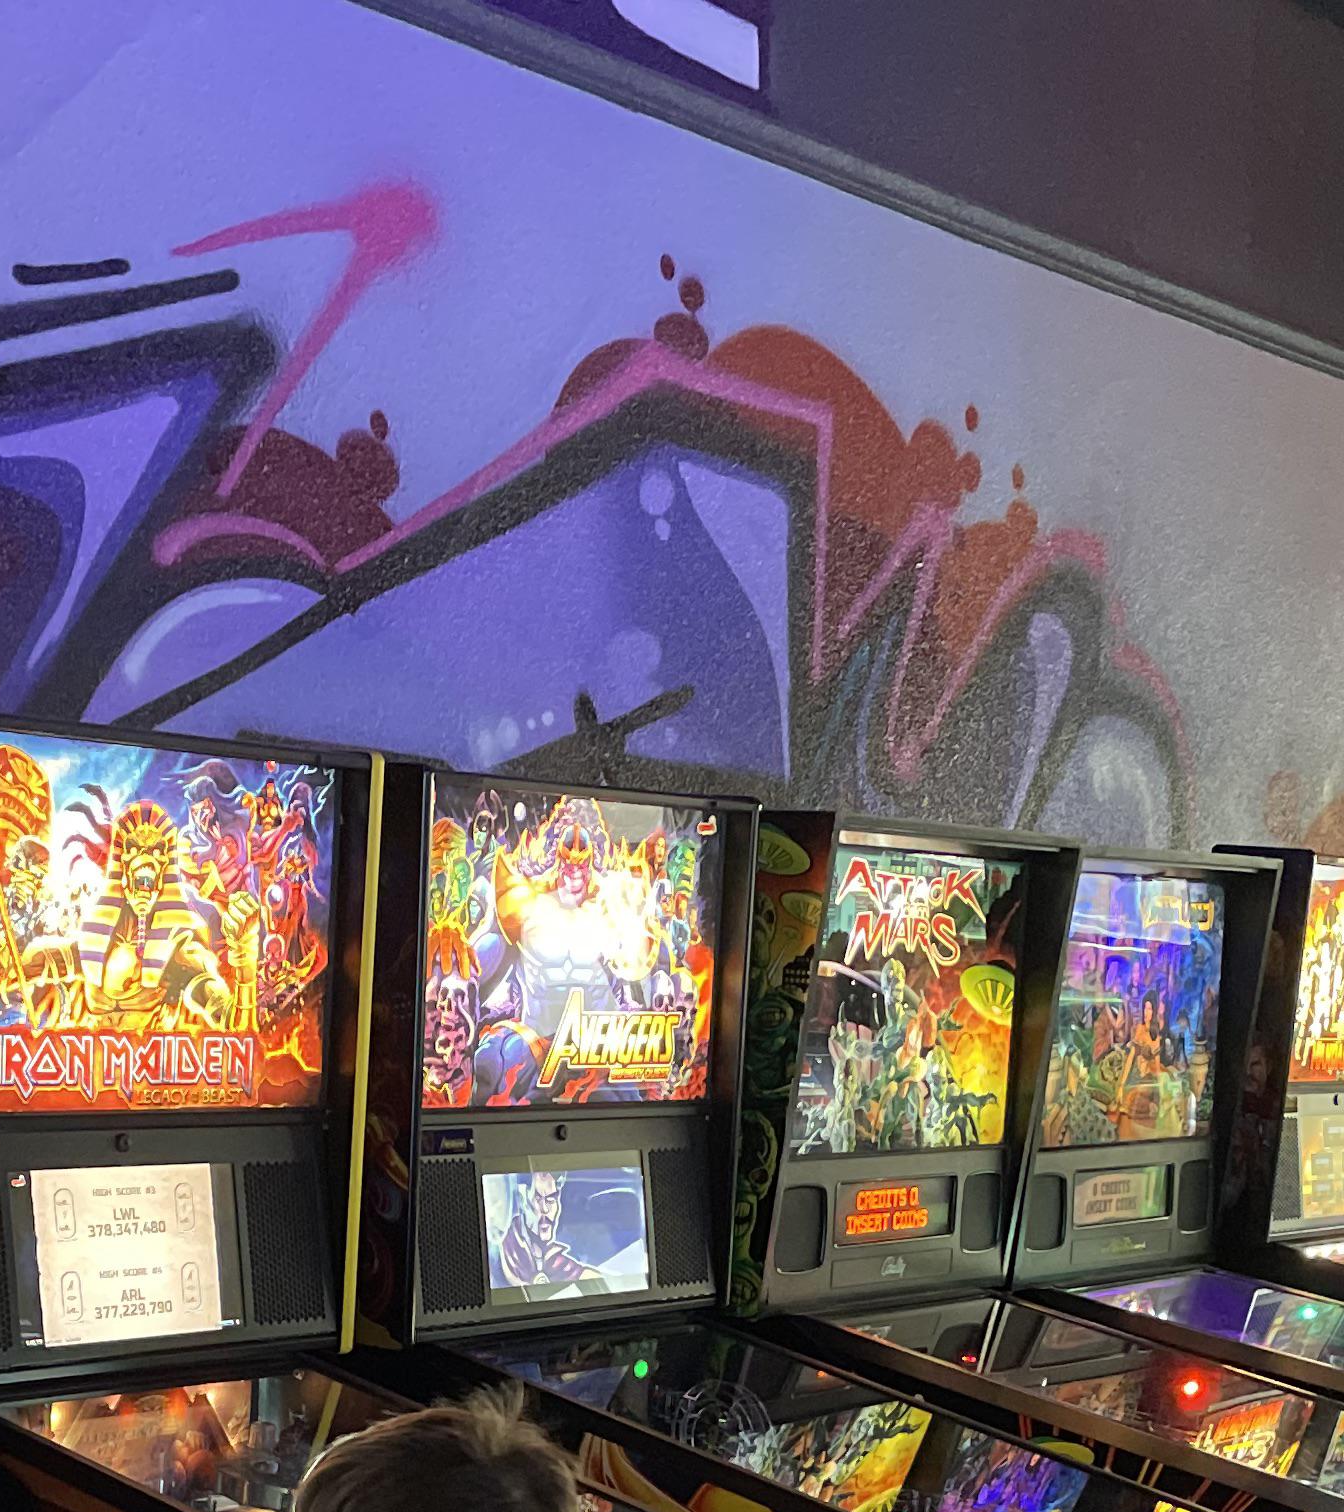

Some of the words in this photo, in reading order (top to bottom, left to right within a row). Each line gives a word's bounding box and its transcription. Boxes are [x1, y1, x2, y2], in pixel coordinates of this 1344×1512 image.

[835, 856, 987, 924] ATTACK
[844, 910, 961, 979] MARS
[539, 989, 680, 1085] AVENGERS
[103, 1034, 255, 1101] MAIDEN
[136, 1088, 190, 1105] LEGACY
[202, 1088, 244, 1103] BEAST
[116, 1187, 142, 1196] SCORE
[856, 1187, 907, 1211] CREDITS
[112, 1207, 141, 1221] LWL
[845, 1212, 891, 1235] INSERT
[892, 1208, 929, 1231] COINS
[87, 1220, 167, 1238] 378,347,480
[122, 1268, 148, 1277] SCORE
[120, 1289, 146, 1302] ARL
[94, 1300, 173, 1319] 377,229,790
